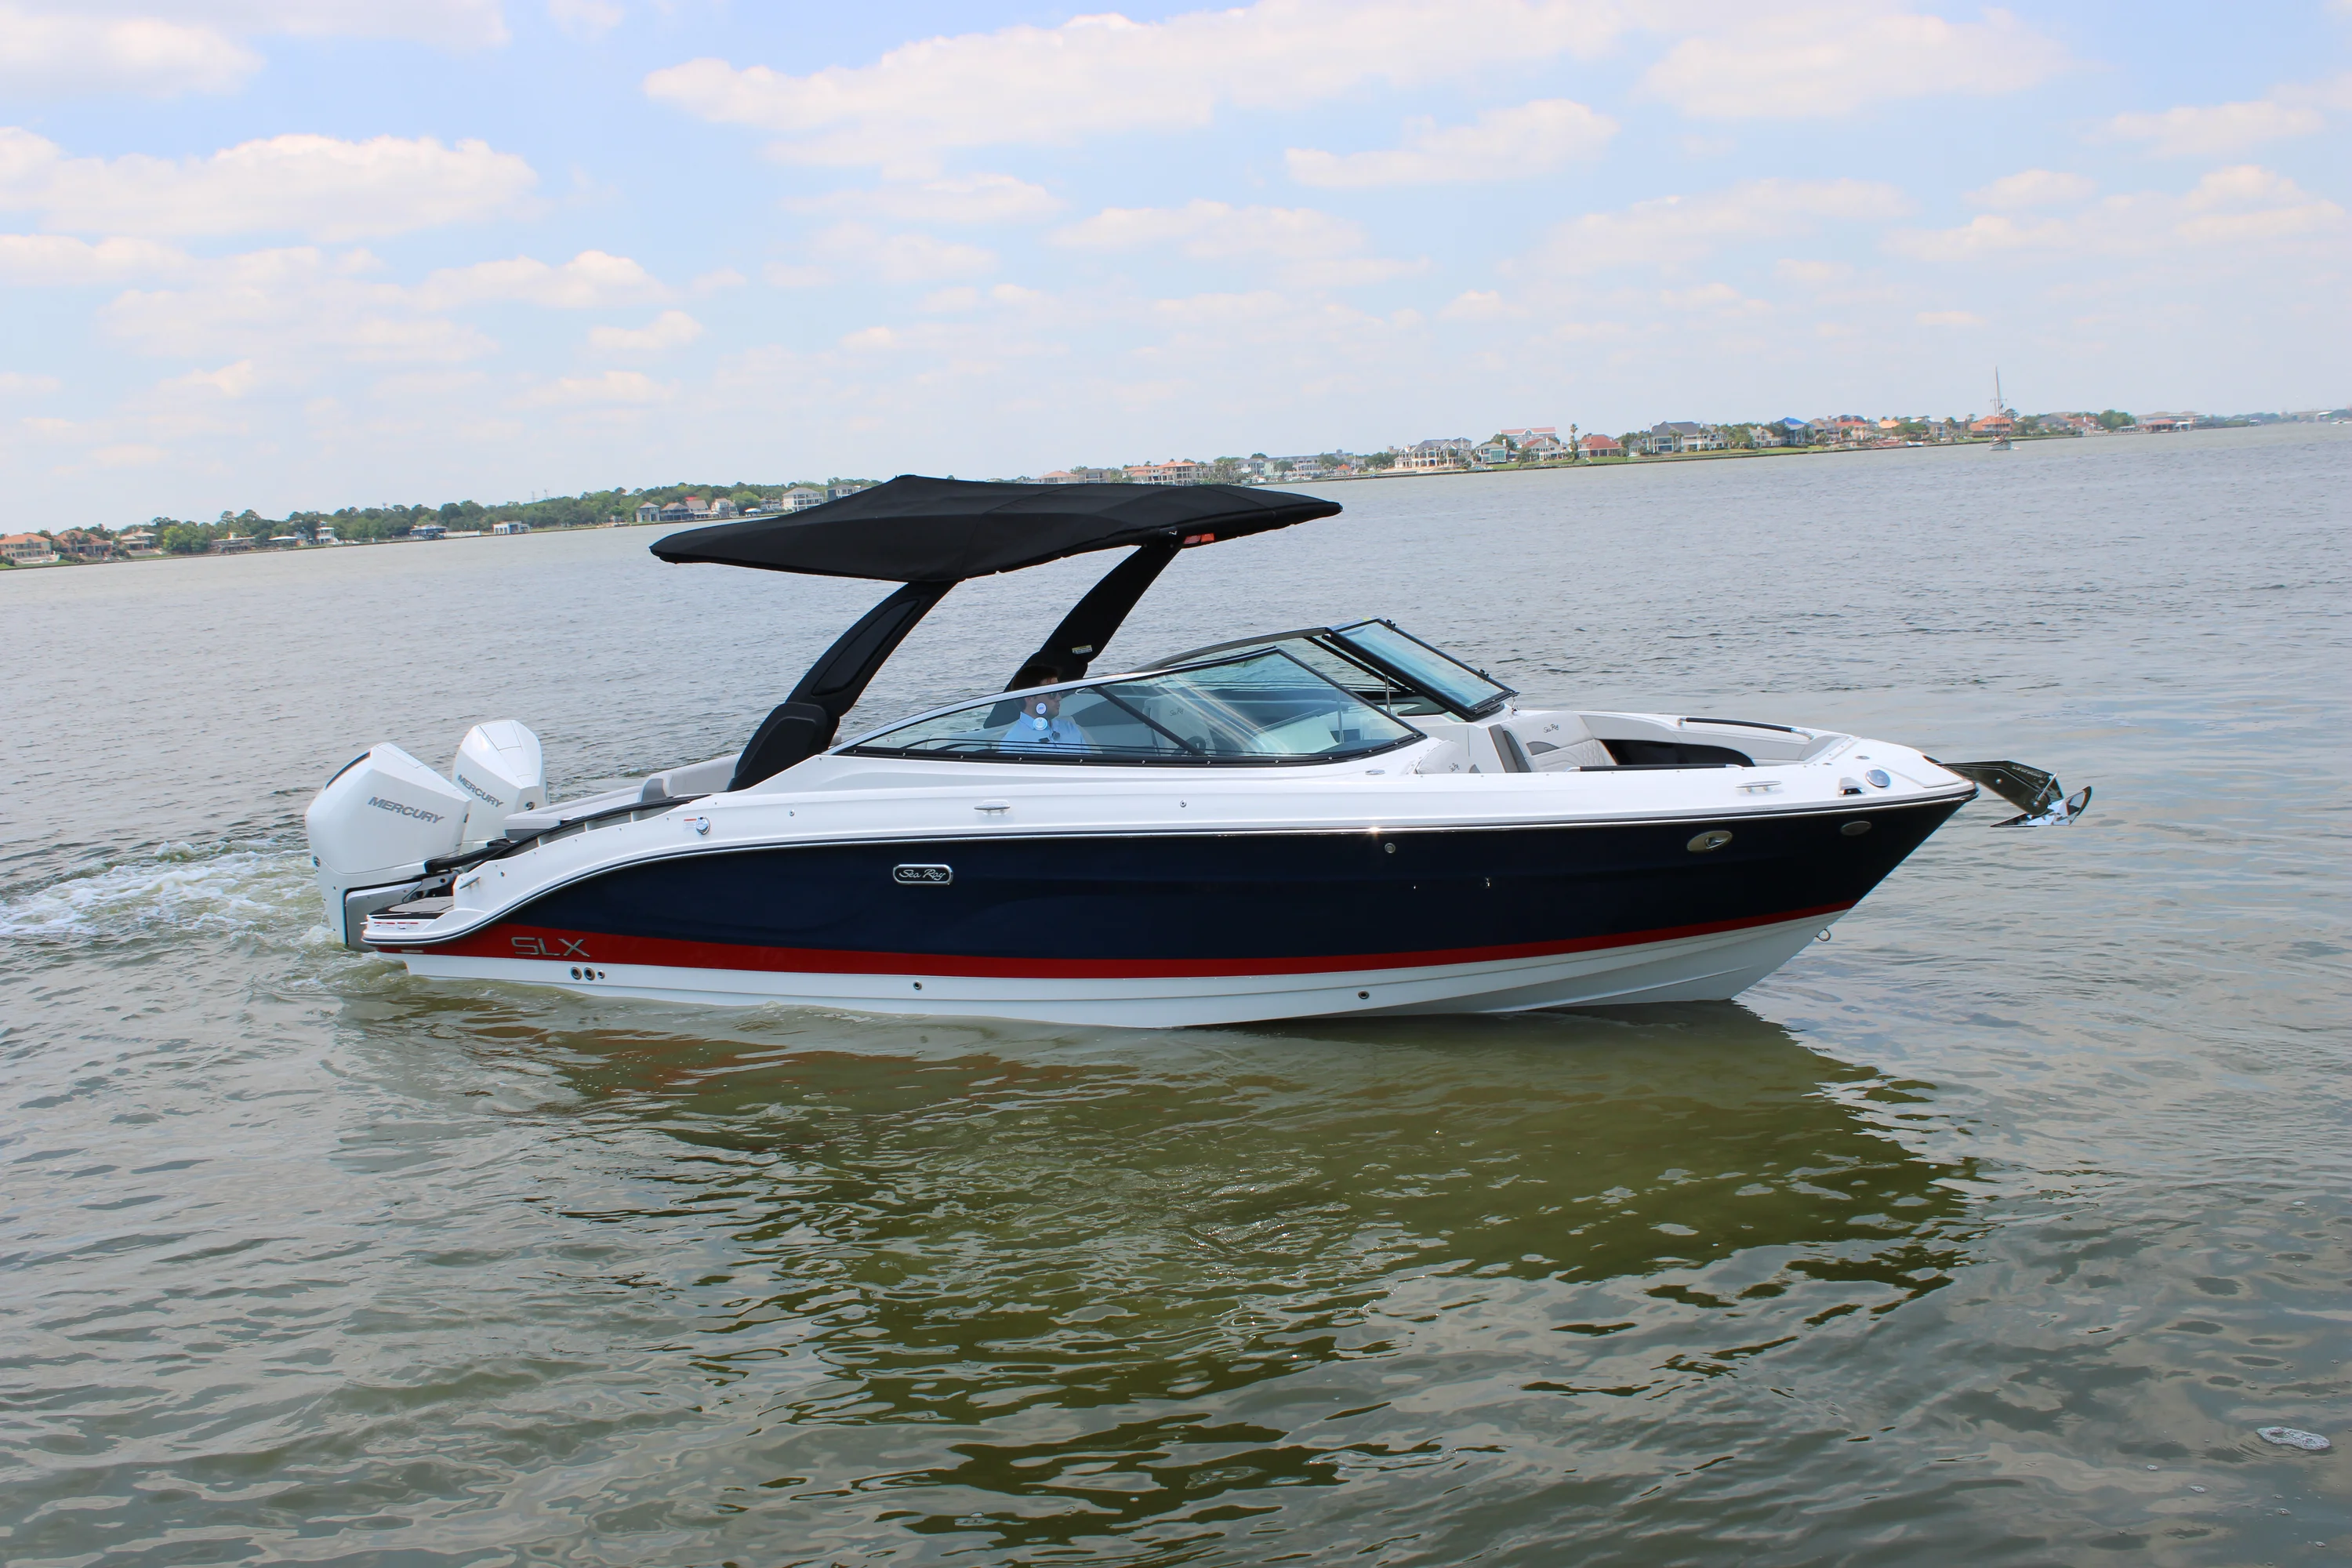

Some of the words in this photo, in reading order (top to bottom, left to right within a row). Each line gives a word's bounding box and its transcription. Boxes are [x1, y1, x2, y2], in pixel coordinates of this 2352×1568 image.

[458, 775, 504, 808] MERCURY
[368, 797, 445, 823] MERCURY
[899, 869, 921, 878] Sea
[923, 869, 946, 880] Ray
[511, 937, 590, 957] SLX
